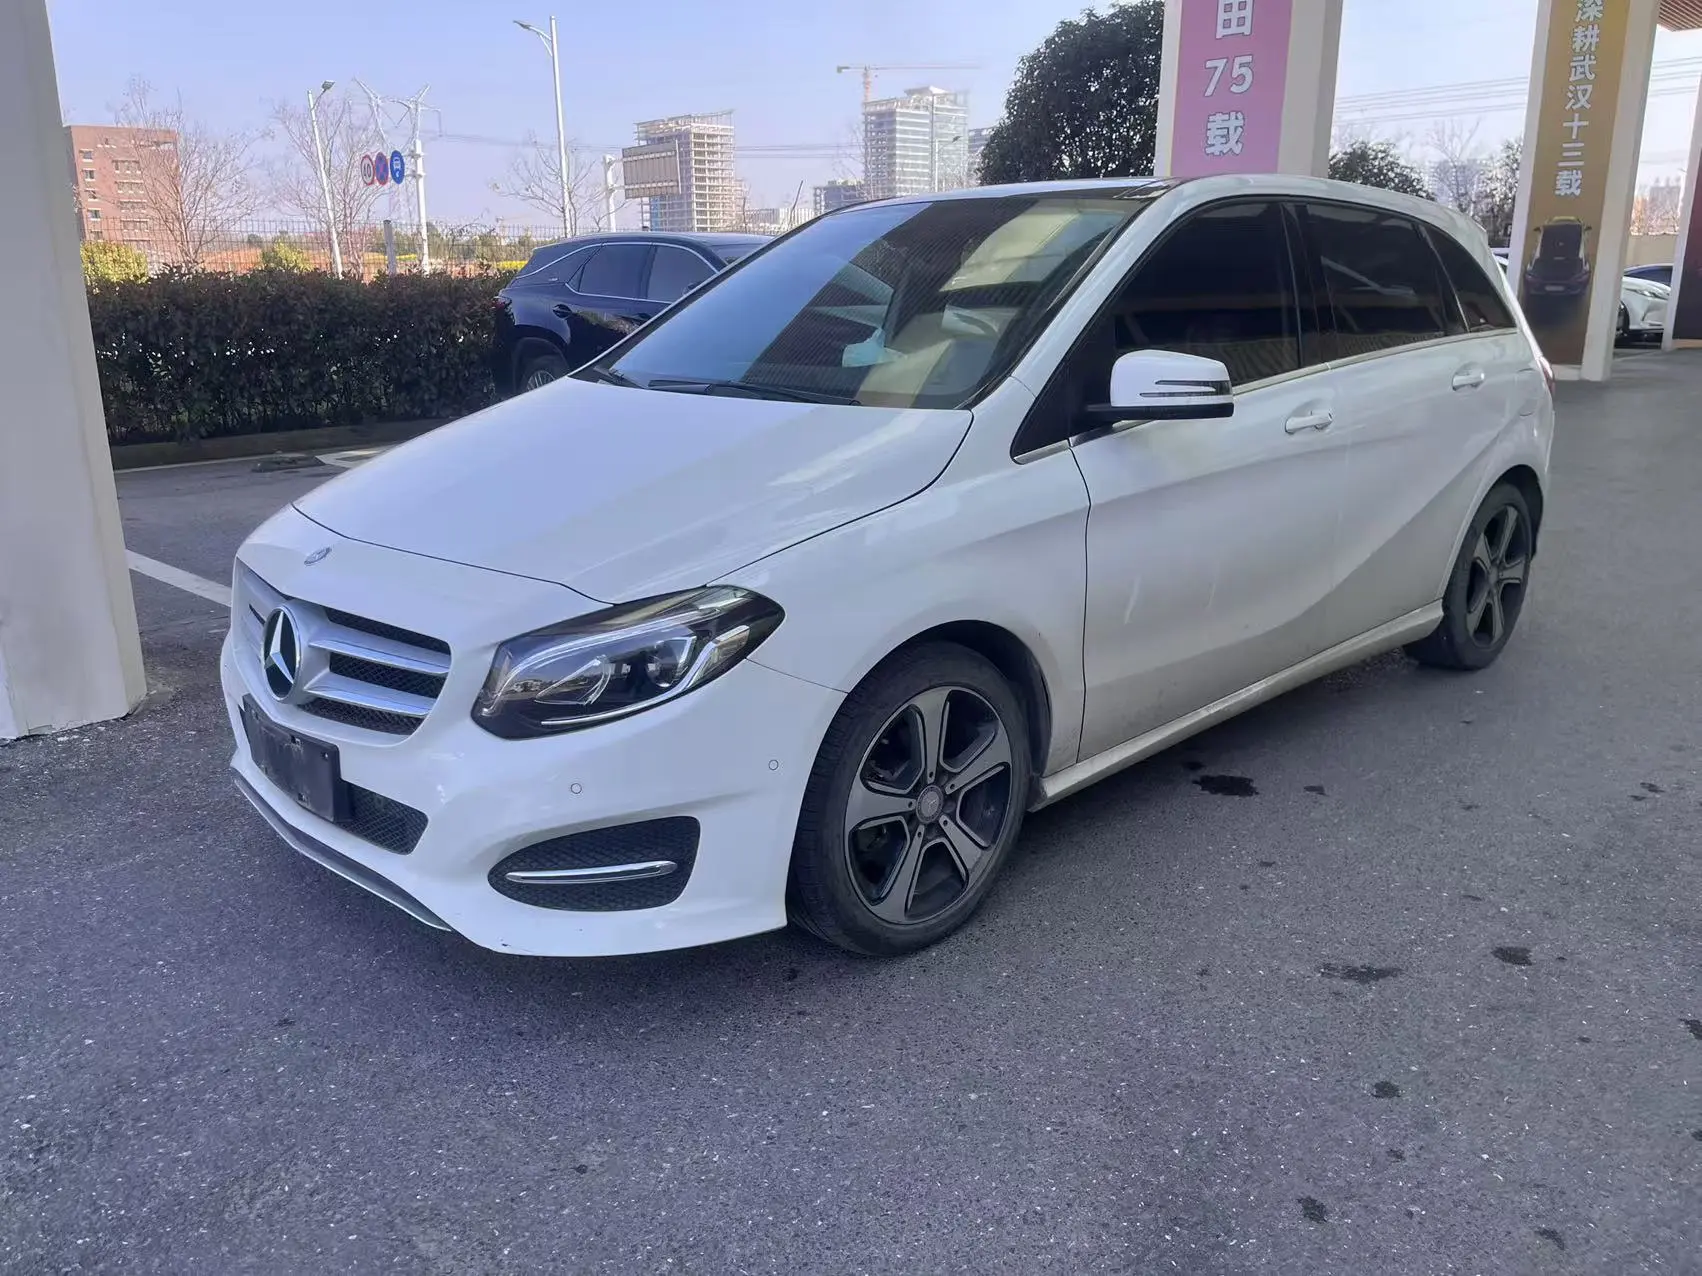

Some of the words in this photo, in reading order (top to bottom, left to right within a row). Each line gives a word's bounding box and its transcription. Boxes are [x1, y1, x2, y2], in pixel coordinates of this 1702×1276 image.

[1555, 0, 1603, 196] 深耕武汉十三载
